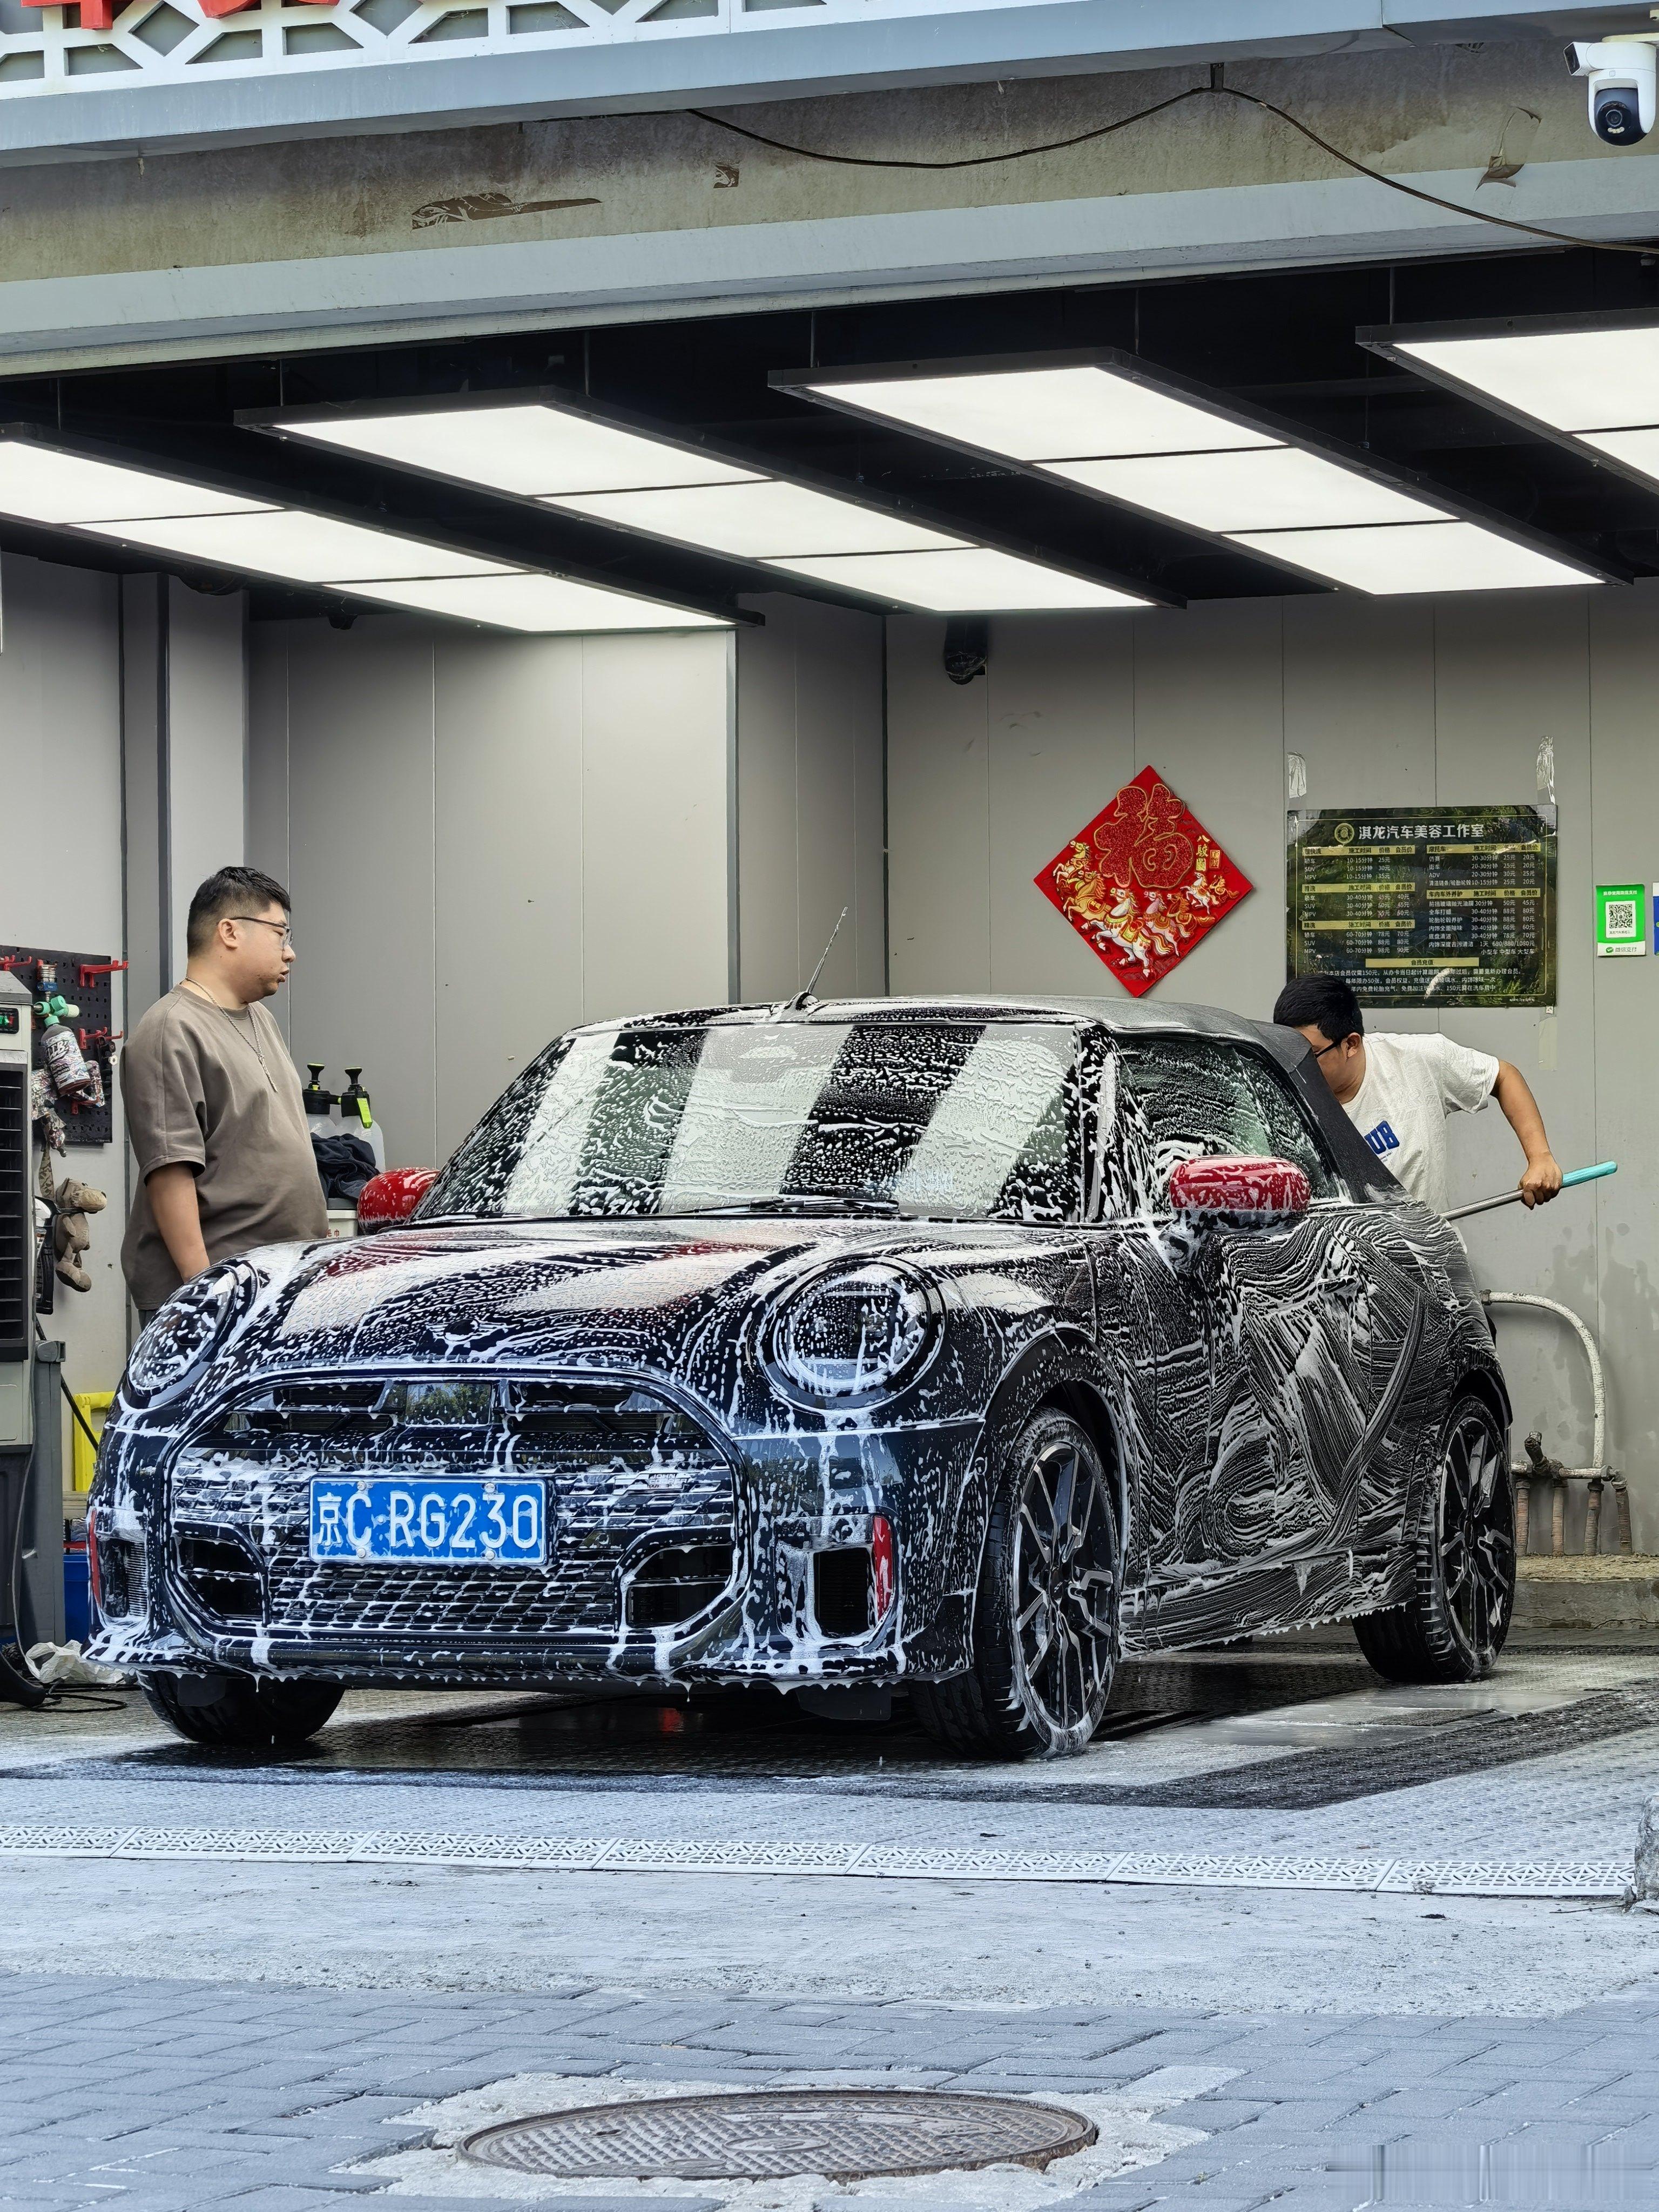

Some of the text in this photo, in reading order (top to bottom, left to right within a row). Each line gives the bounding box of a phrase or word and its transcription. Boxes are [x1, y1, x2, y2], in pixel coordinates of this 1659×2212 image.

[1359, 824, 1484, 839] 淇龙汽车美容工作室
